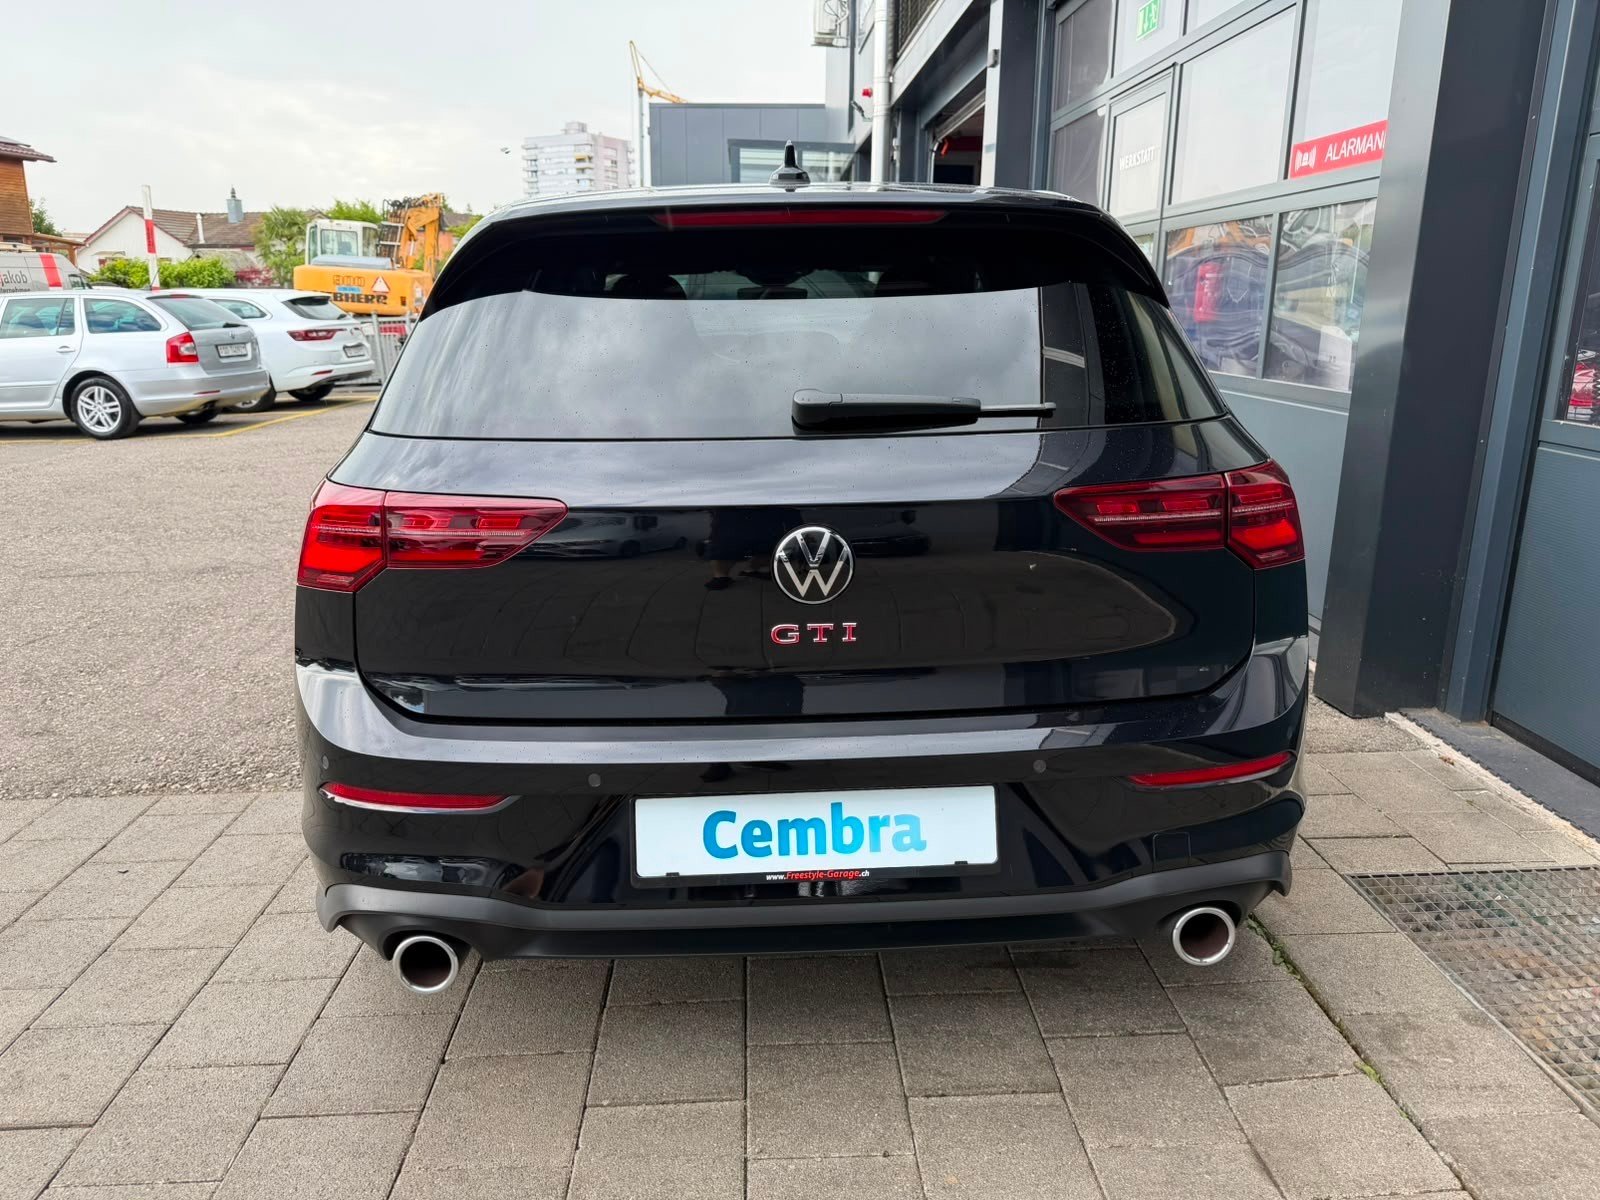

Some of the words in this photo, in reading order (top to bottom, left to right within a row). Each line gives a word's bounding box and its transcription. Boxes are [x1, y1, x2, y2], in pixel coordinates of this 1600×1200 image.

[770, 622, 858, 645] GTI
[702, 801, 928, 860] Cembra
[765, 869, 870, 881] www.Freestyle-Garage.ch
